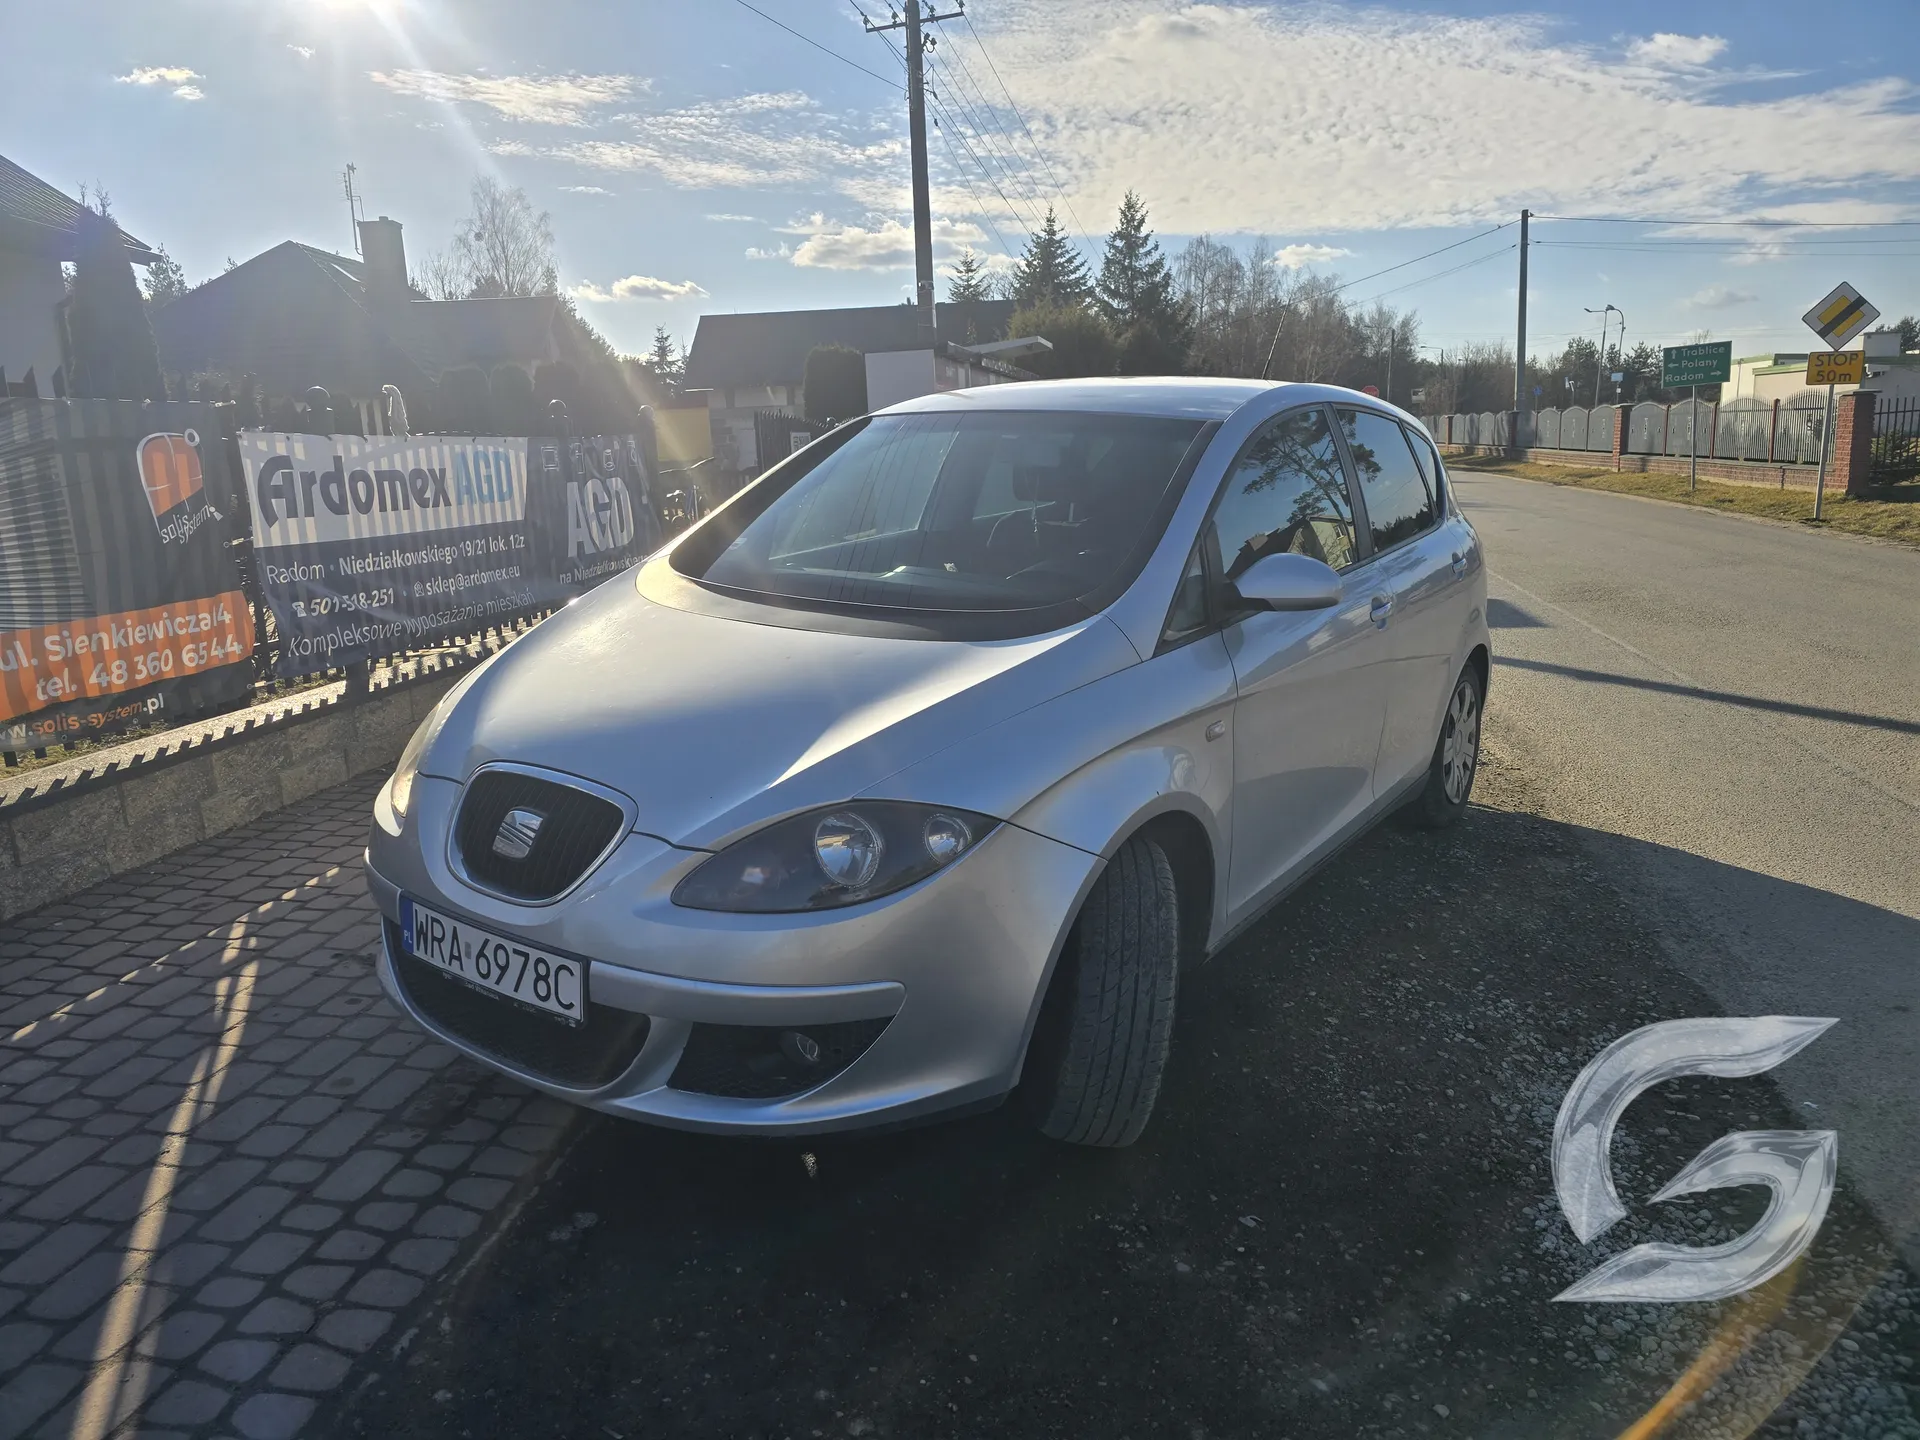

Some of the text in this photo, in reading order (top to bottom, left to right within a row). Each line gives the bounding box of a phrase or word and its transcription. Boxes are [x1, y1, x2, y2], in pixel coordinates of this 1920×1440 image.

[1681, 345, 1725, 357] Trablice
[1681, 359, 1718, 369] Polany
[1815, 353, 1859, 367] STOP
[1665, 372, 1704, 382] Radom
[257, 448, 514, 529] Ardomex AGD
[160, 513, 190, 544] solis
[566, 476, 634, 558] AGD
[266, 533, 526, 585] Radom Niedziałkowskiego 19/21 lok. 12z
[559, 571, 572, 585] na
[425, 565, 521, 597] sklep@ardomex.eu
[0, 640, 39, 671] ul.
[44, 611, 212, 662] Sienkiewicza
[287, 620, 402, 658] Kompleksowe
[486, 587, 537, 616] mieszkań
[36, 633, 244, 701] tel. 48 360 6544
[414, 908, 464, 972] WRA
[475, 937, 576, 1011] 6978C
